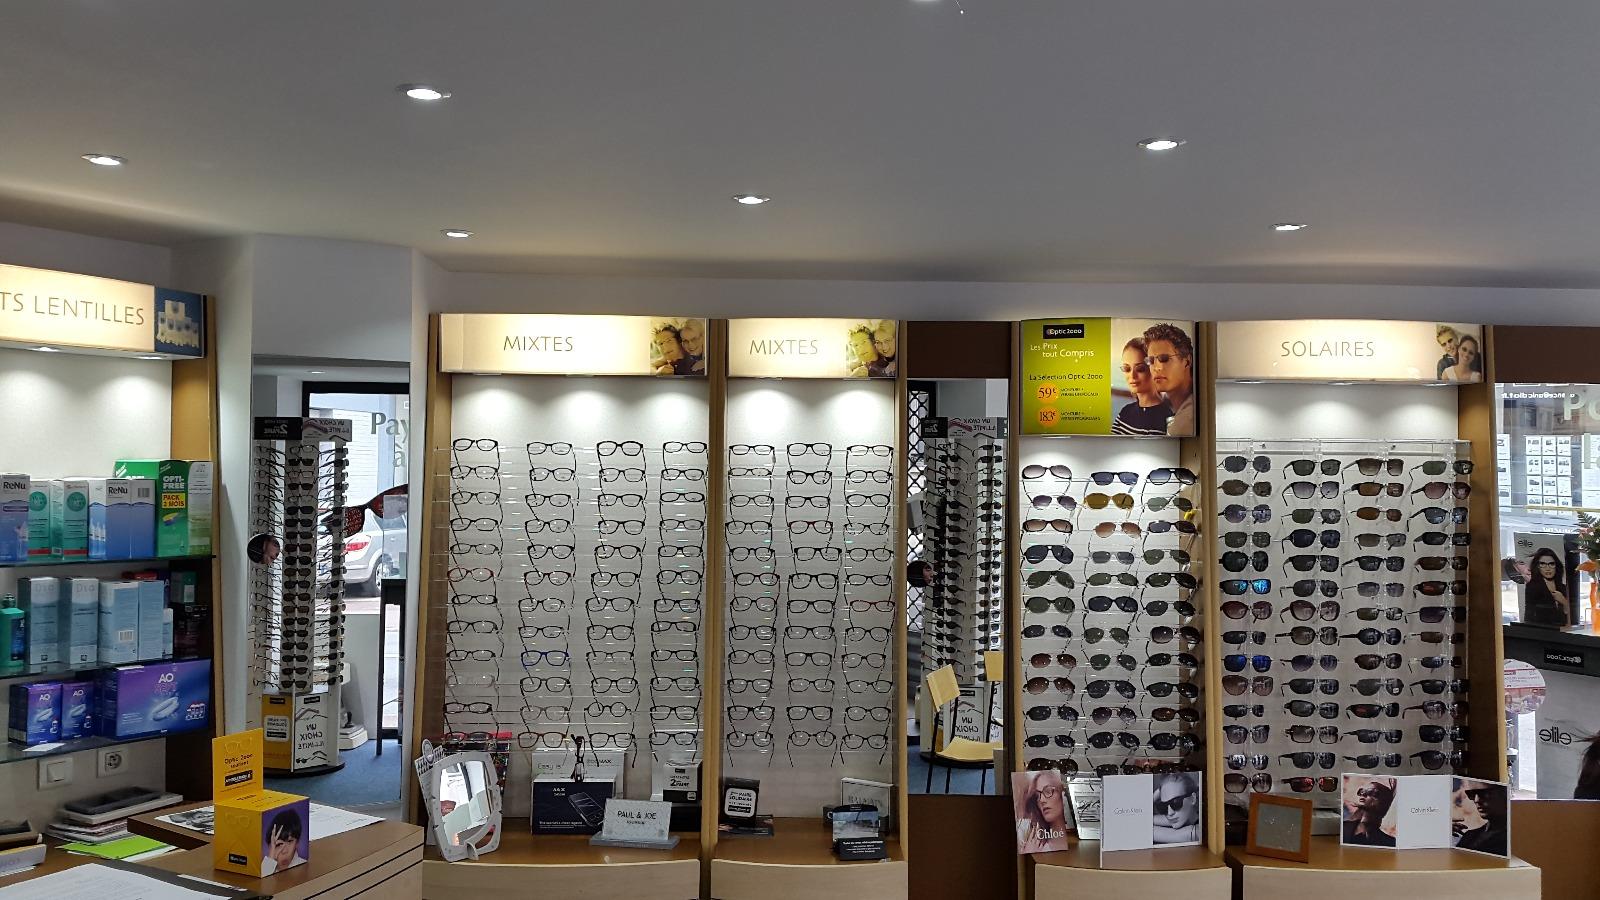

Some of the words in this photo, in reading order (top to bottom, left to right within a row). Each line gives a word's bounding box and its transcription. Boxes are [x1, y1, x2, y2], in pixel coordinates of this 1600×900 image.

[0, 291, 24, 312] TS
[34, 295, 145, 326] LENTILLES
[1048, 328, 1067, 336] Optic
[503, 335, 573, 352] MIXTES
[749, 339, 818, 355] MIXTES
[1043, 342, 1058, 350] Prix
[1059, 348, 1095, 359] Compris
[1281, 341, 1374, 357] SOLAIRES
[1067, 373, 1086, 381] Optic
[162, 475, 185, 483] OPTI-
[3, 481, 27, 490] ReNu
[108, 486, 128, 495] ReNu
[162, 482, 185, 490] FREE
[158, 672, 175, 684] AO
[617, 810, 635, 819] PAUL
[636, 811, 642, 819] &
[644, 812, 658, 820] JOE
[1036, 827, 1065, 840] Chloé
